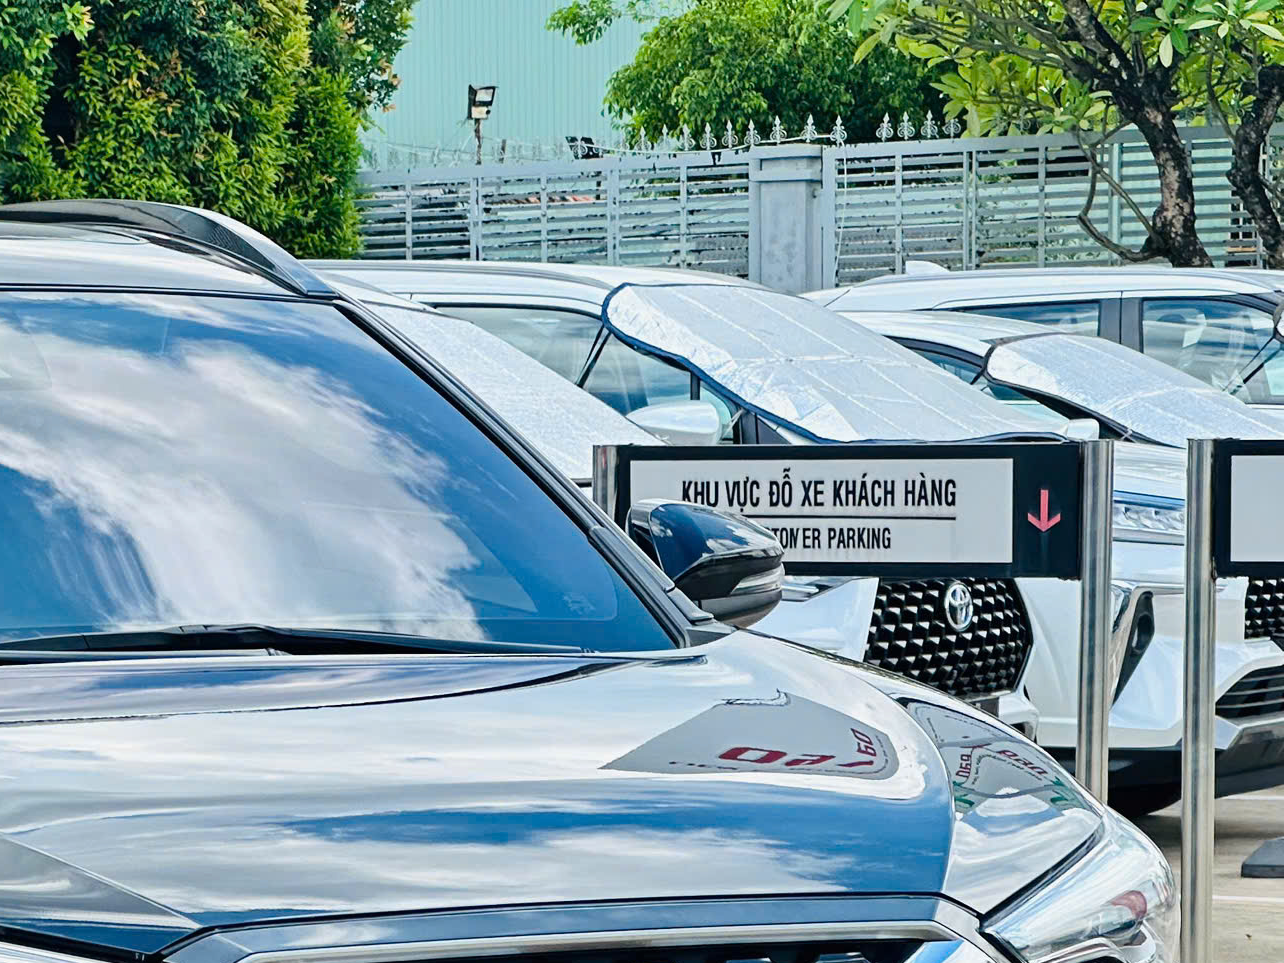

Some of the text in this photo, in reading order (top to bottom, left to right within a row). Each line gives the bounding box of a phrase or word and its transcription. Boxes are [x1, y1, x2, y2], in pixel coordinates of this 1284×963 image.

[682, 467, 956, 512] KHU VỰC ĐỖ XE KHÁCH HÀNG
[773, 527, 891, 549] TOMER PARKING
